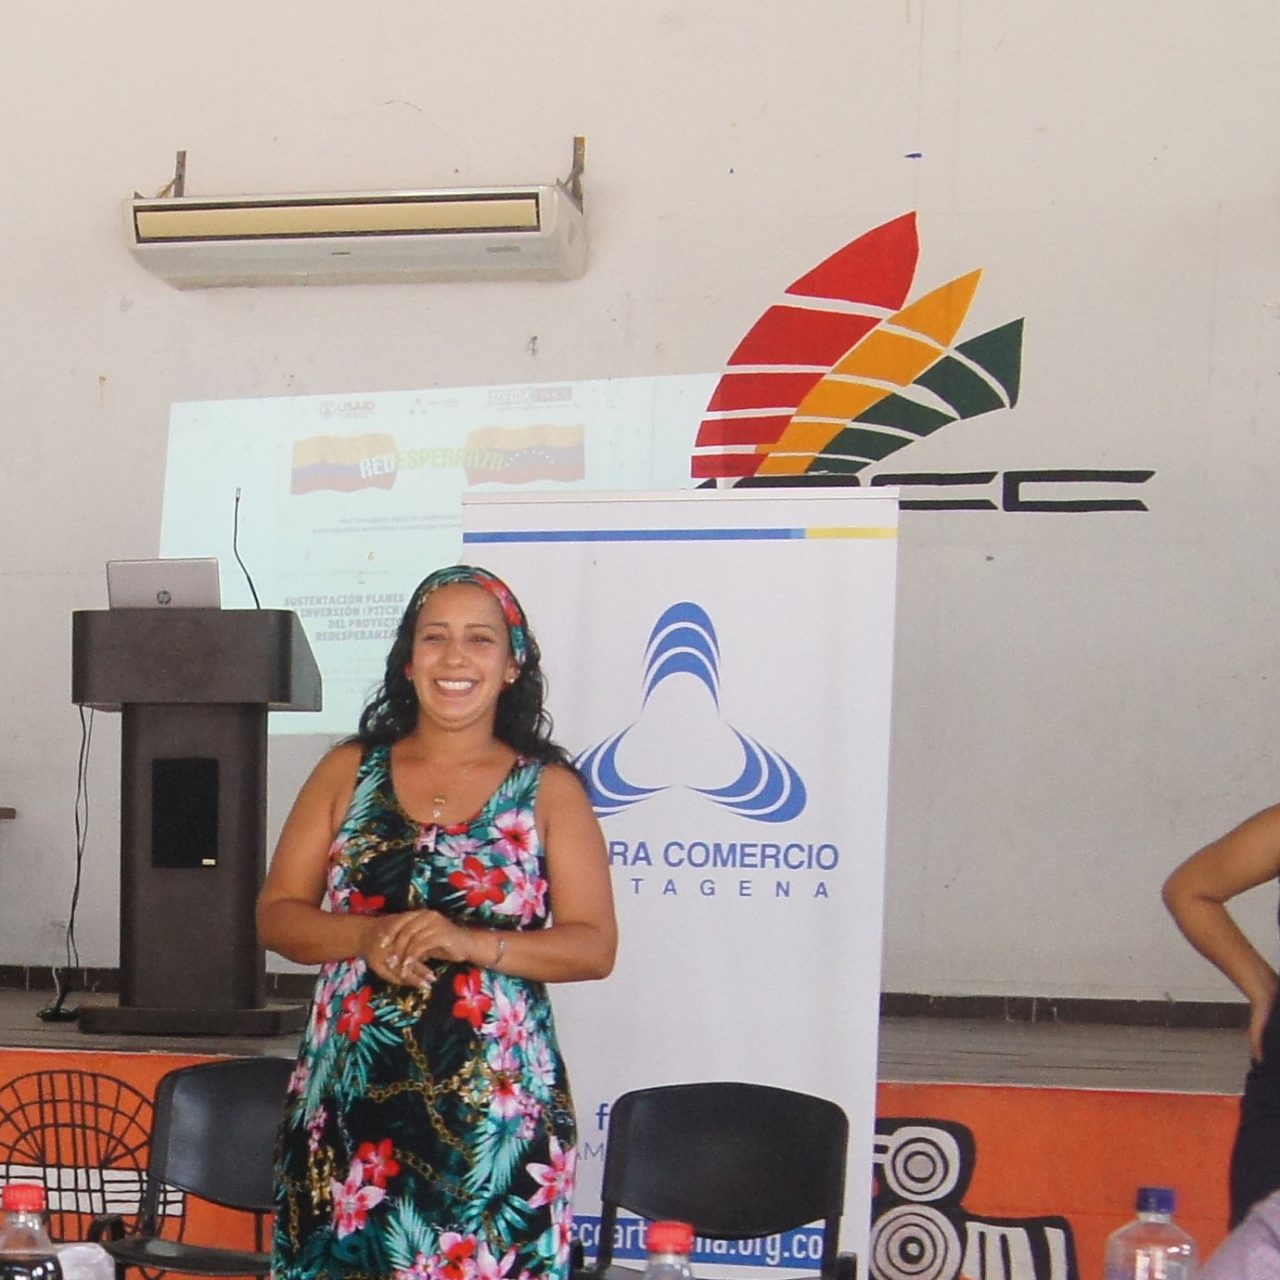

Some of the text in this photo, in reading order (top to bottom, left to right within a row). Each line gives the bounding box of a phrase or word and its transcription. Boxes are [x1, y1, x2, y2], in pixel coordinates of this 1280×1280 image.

[365, 592, 404, 604] PLANES
[328, 619, 346, 629] DEL
[663, 841, 839, 870] COMERCIO
